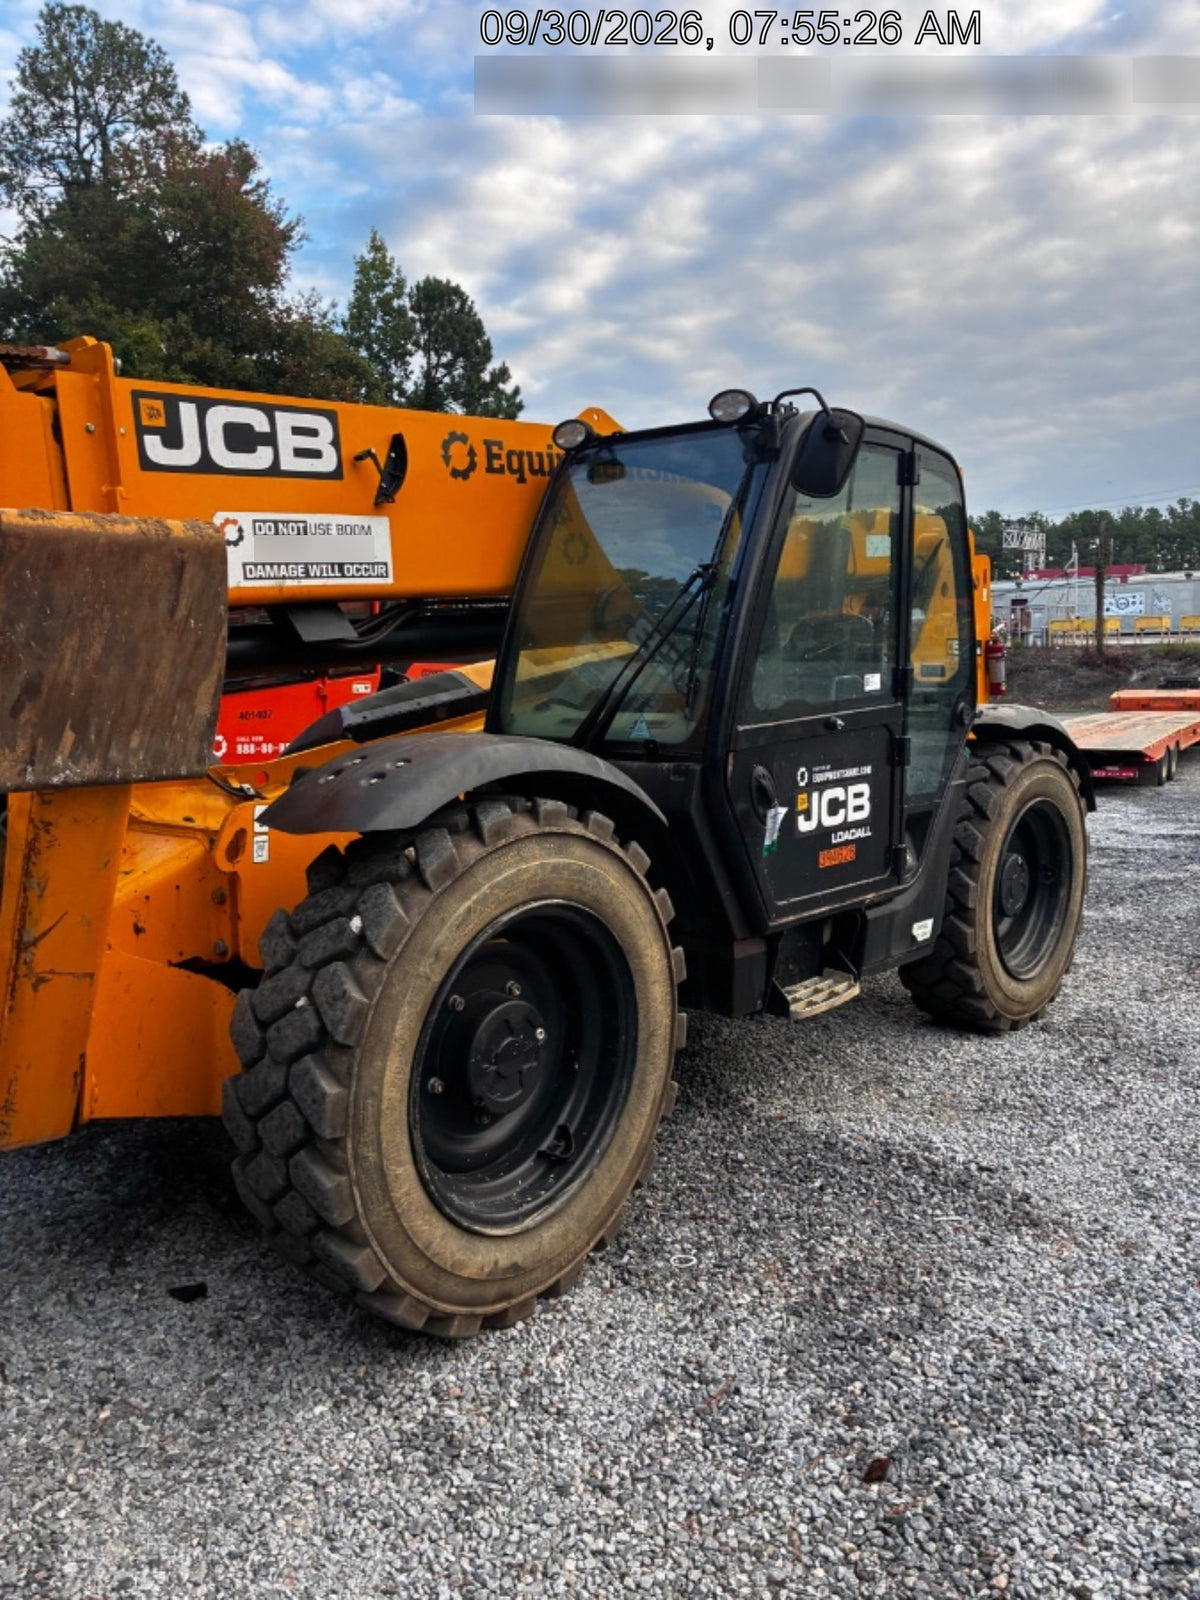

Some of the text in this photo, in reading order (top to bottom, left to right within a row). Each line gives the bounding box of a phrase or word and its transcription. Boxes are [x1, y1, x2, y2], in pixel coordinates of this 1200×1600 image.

[143, 401, 338, 473] JCB
[255, 522, 372, 535] DO NOT USE BOOM
[245, 563, 387, 579] DAMAGE WILL OCCUR
[797, 783, 871, 832] JCB
[831, 826, 872, 844] LOADALL
